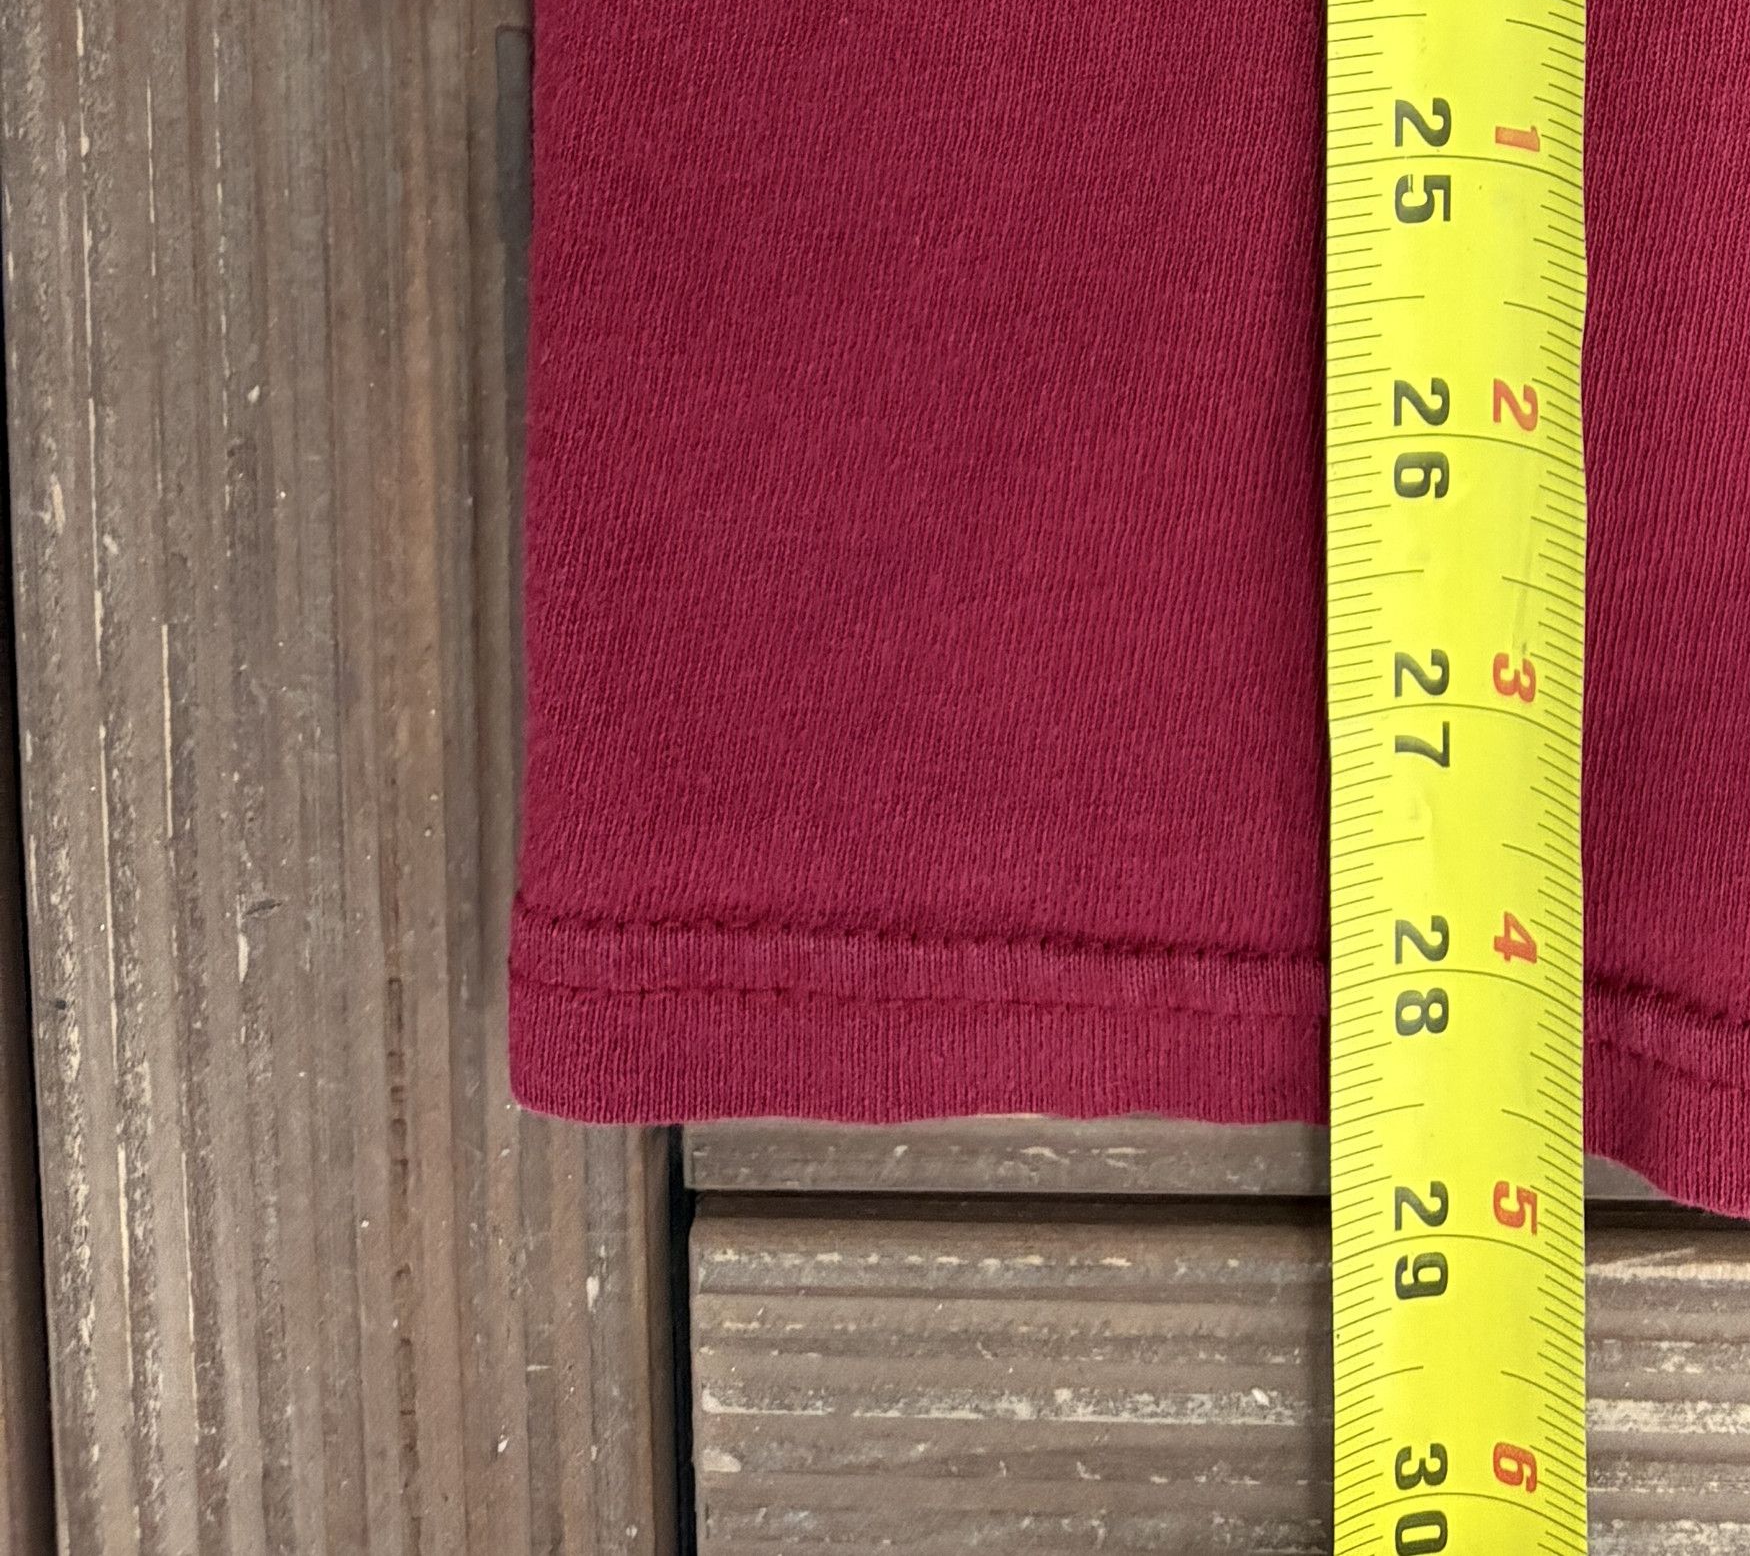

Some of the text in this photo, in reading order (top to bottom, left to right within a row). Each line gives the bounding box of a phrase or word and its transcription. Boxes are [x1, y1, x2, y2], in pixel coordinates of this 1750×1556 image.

[1394, 97, 1452, 223] 25
[1494, 125, 1540, 151] 1
[1393, 378, 1450, 499] 26
[1492, 378, 1538, 432] 2
[1394, 649, 1450, 768] 27
[1492, 651, 1536, 704] 3
[1394, 914, 1450, 1036] 28
[1493, 911, 1537, 964] 4
[1394, 1181, 1449, 1300] 29
[1492, 1180, 1537, 1235] 5
[1394, 1442, 1448, 1556] 30
[1492, 1442, 1537, 1493] 6
